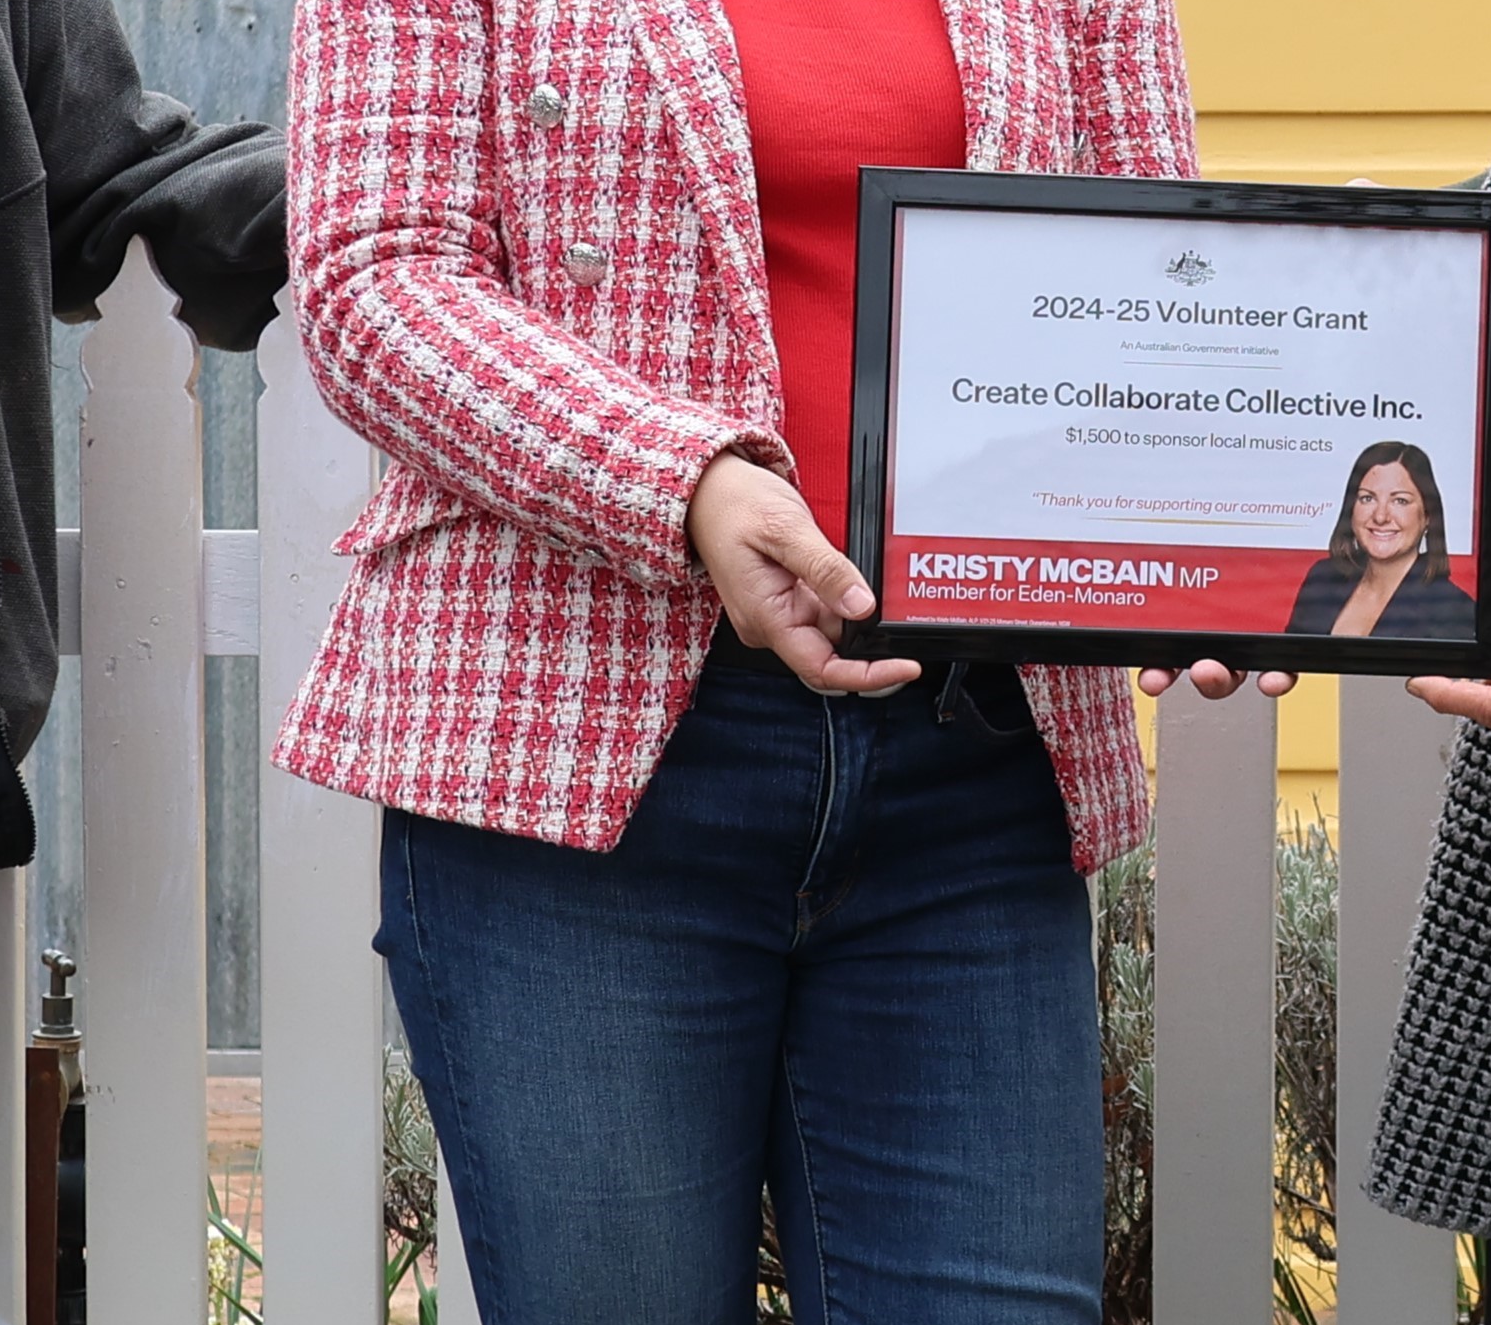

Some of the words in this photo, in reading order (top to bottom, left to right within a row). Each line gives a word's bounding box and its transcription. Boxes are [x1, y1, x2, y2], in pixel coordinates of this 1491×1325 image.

[1031, 295, 1151, 322] 2024-25
[1155, 300, 1289, 327] Volunteer
[1293, 305, 1369, 331] Grant
[1120, 341, 1134, 350] An
[1134, 341, 1181, 353] Australian
[1182, 343, 1240, 355] Government
[1240, 345, 1280, 356] initiative
[951, 378, 1049, 405] Create
[1054, 381, 1221, 412] Collaborate
[1226, 387, 1367, 418] Collective
[1372, 393, 1423, 420] Inc.
[1065, 425, 1122, 446] $1,500
[1124, 431, 1141, 446] to
[1143, 433, 1209, 450] sponsor
[1210, 432, 1247, 449] local
[1249, 435, 1298, 451] music
[1299, 437, 1333, 453] acts
[1085, 497, 1114, 511] you
[1115, 494, 1135, 509] for
[1136, 497, 1213, 514] supporting
[1214, 501, 1239, 513] our
[909, 553, 1035, 583] KRISTY
[1040, 557, 1174, 587] MCBAIN
[1180, 566, 1219, 589] MP
[909, 581, 987, 601] Member
[990, 583, 1016, 602] for
[1018, 584, 1146, 606] Eden-Monaro
